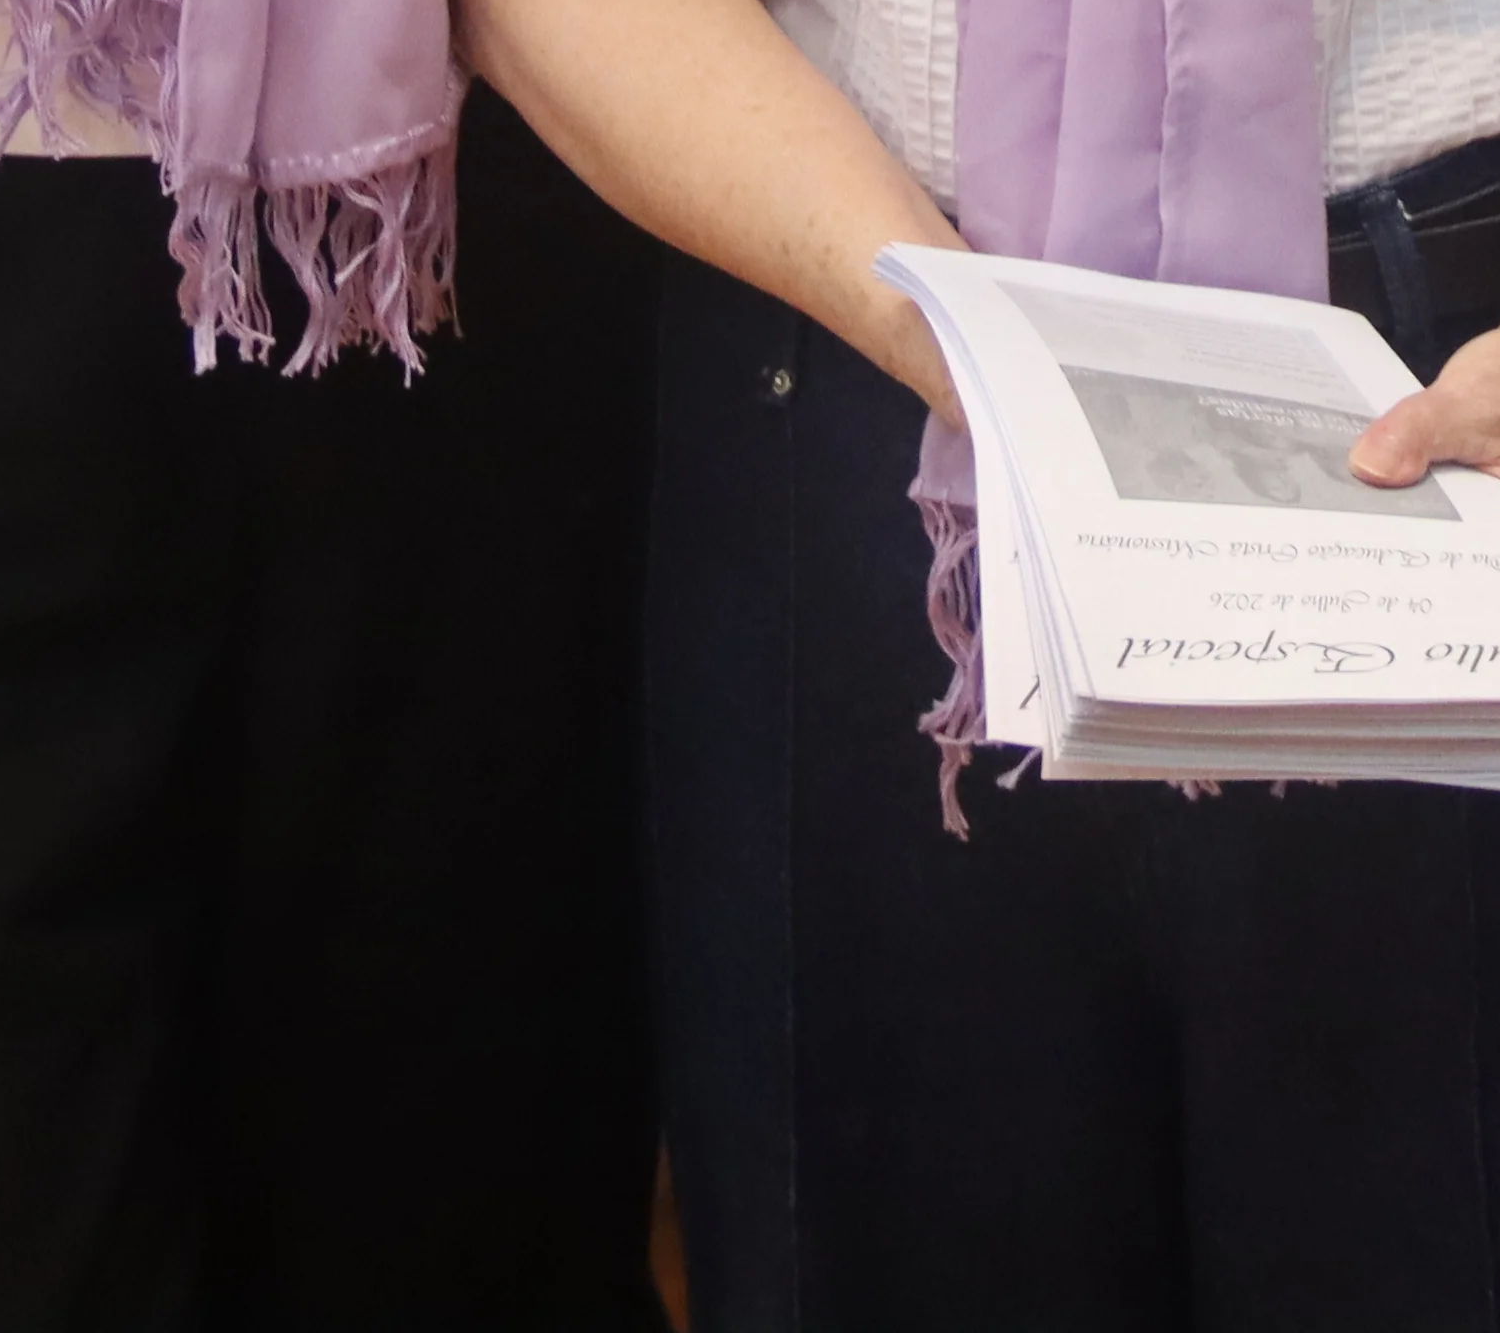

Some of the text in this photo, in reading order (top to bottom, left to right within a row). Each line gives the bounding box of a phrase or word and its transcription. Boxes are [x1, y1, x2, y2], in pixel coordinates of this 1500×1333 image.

[1075, 532, 1220, 560] Missionária
[1228, 541, 1299, 563] Cristã
[1307, 541, 1430, 568] Educação
[1439, 551, 1463, 569] de
[1209, 591, 1264, 612] 2026
[1271, 593, 1295, 611] de
[1300, 590, 1371, 614] Julho
[1377, 596, 1399, 613] de
[1116, 629, 1395, 673] Especial
